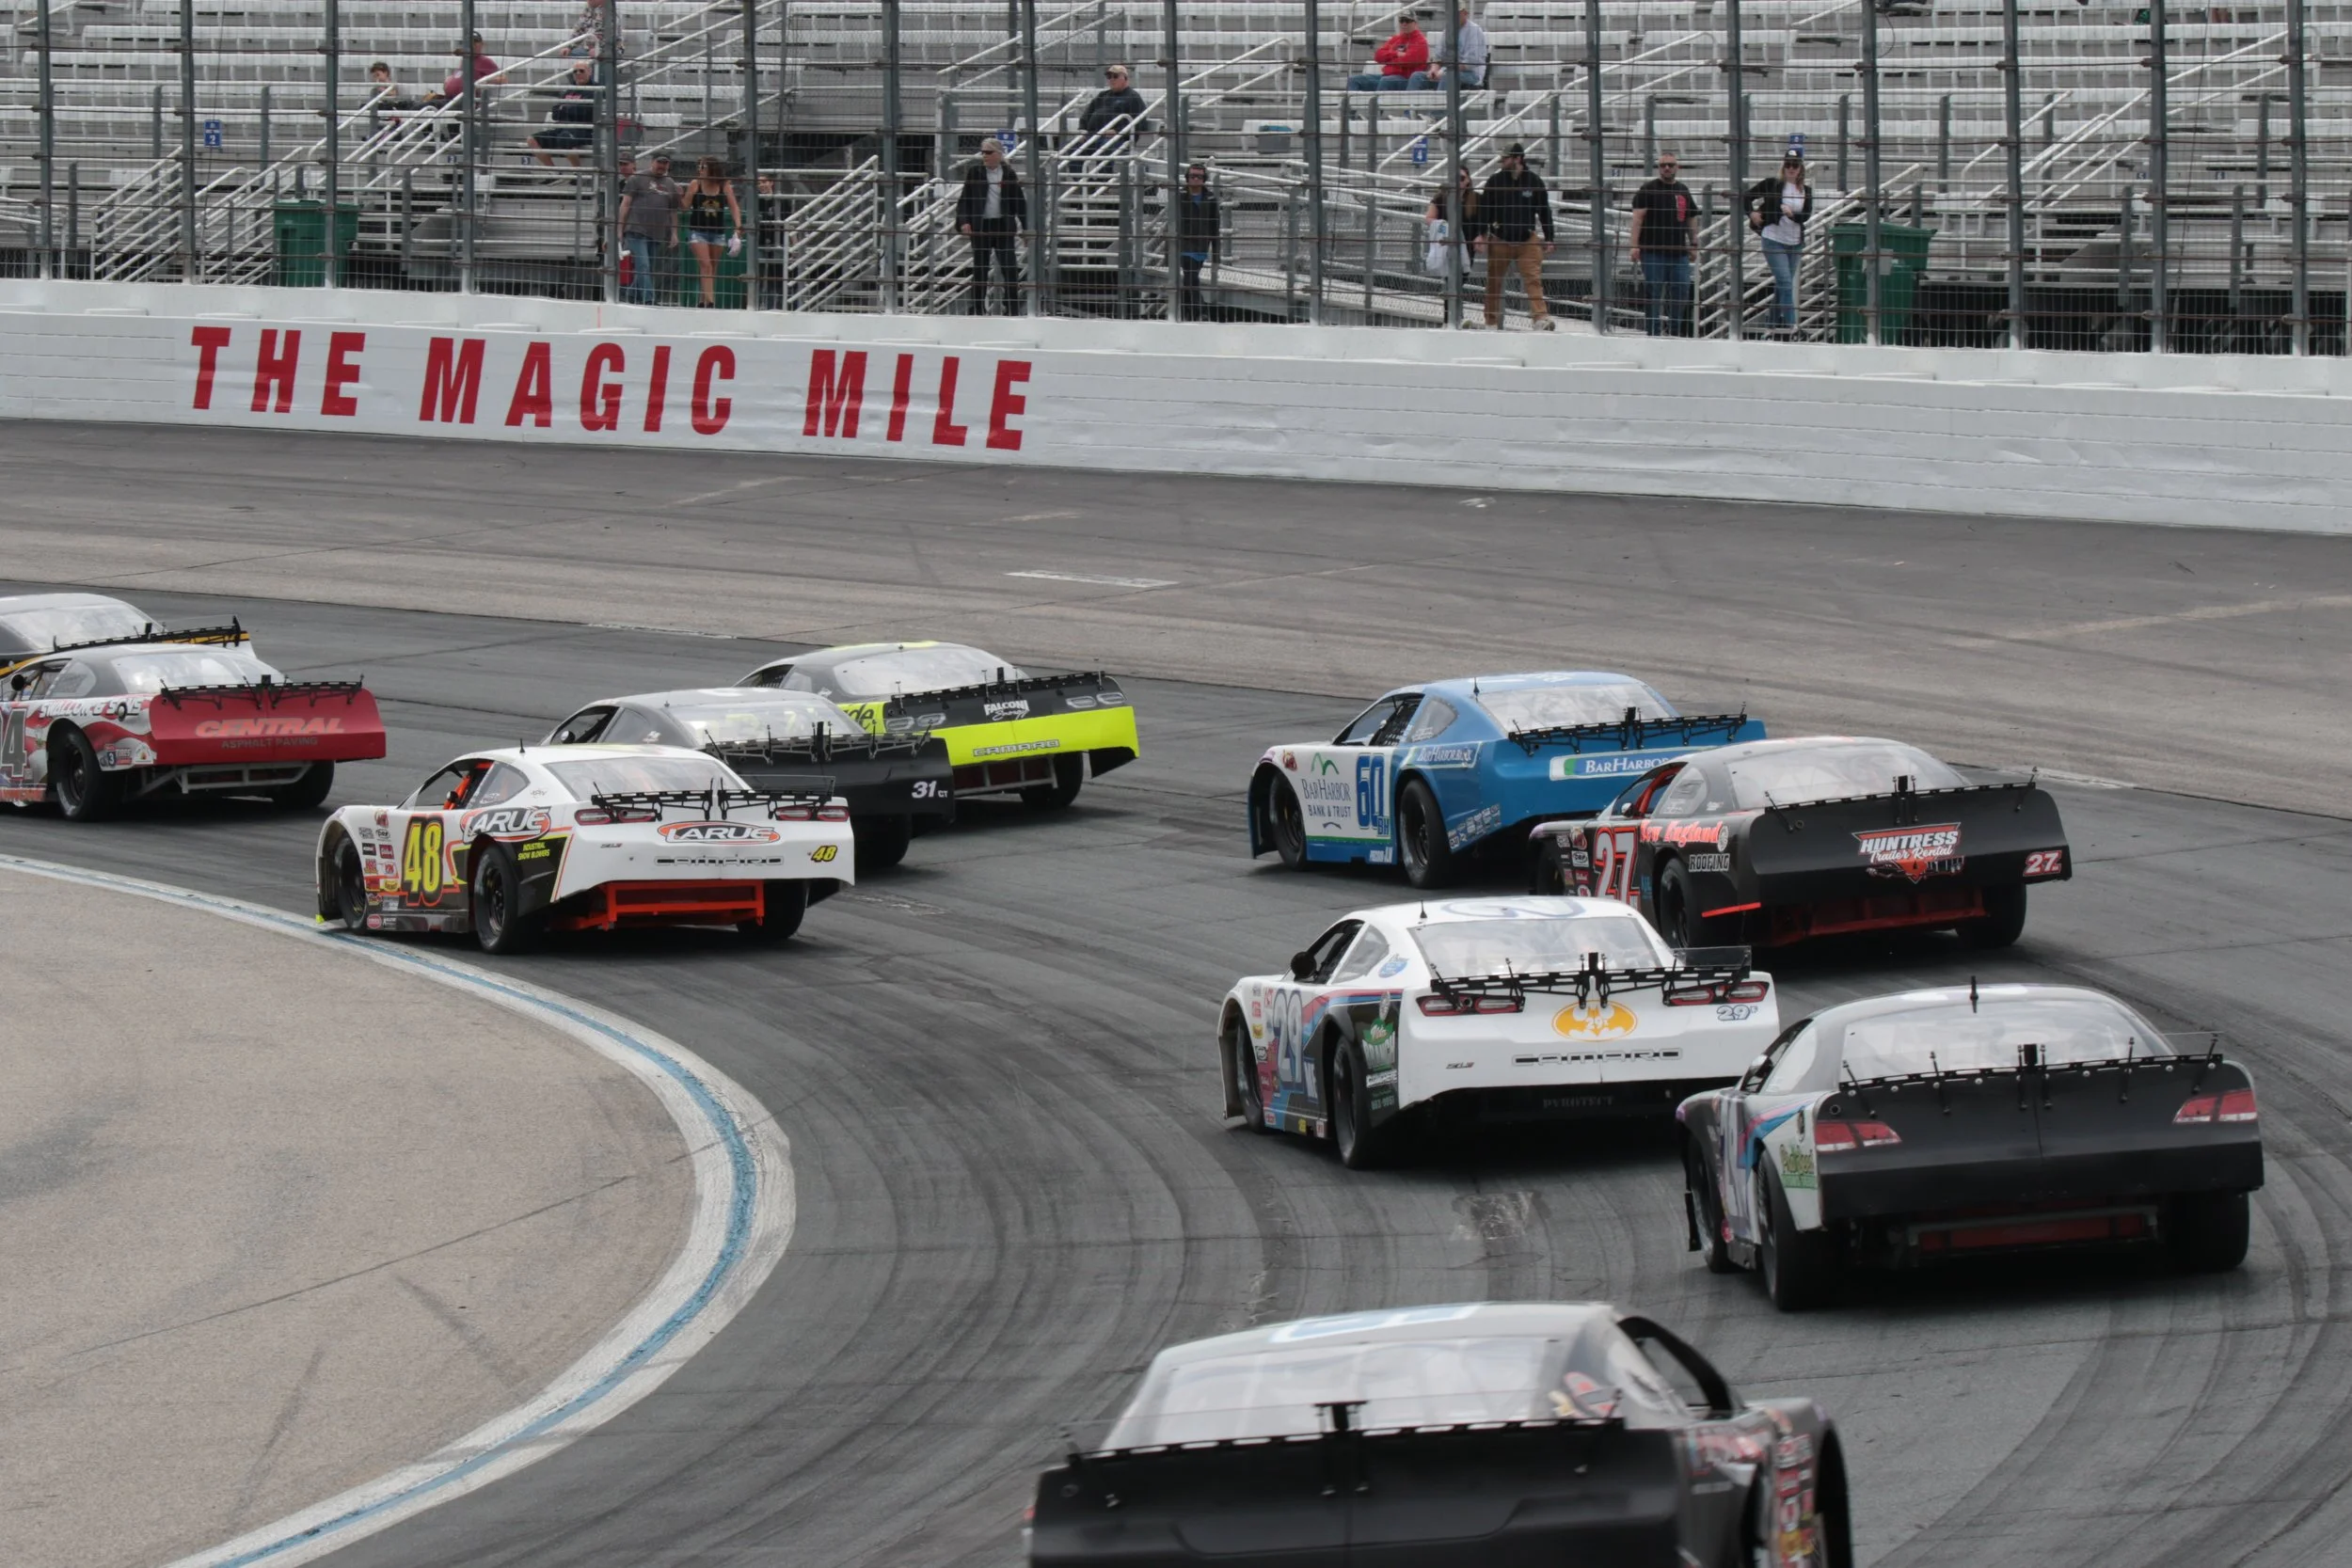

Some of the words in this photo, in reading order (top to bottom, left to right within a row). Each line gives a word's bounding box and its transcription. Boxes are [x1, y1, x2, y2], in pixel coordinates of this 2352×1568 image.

[191, 326, 365, 417] THE
[419, 337, 736, 436] MAGIC
[802, 349, 1032, 451] MILE
[195, 718, 344, 737] CENTRAL
[0, 707, 27, 778] 4
[221, 737, 273, 749] ASPHALT
[275, 736, 318, 746] PAVING
[973, 739, 1060, 756] CAMARO
[912, 781, 937, 799] 31
[1356, 753, 1384, 830] 60
[1308, 804, 1327, 816] BANK
[1333, 805, 1351, 817] TRUST
[463, 806, 552, 845] LARUE
[666, 825, 776, 844] LARUE
[1640, 818, 1662, 843] New
[1663, 820, 1723, 848] England
[1860, 831, 1959, 853] HUNTRESS
[403, 820, 444, 894] 48
[517, 850, 531, 861] SNOW
[654, 855, 784, 867] CAMARO
[811, 846, 837, 863] 48
[1688, 853, 1730, 873] ROOFING
[1870, 848, 1910, 863] Trailer
[1912, 845, 1953, 860] Rental
[2025, 850, 2061, 876] 27
[1595, 826, 1639, 905] 27
[1716, 1004, 1751, 1021] 29
[1512, 1047, 1682, 1067] CAMARO
